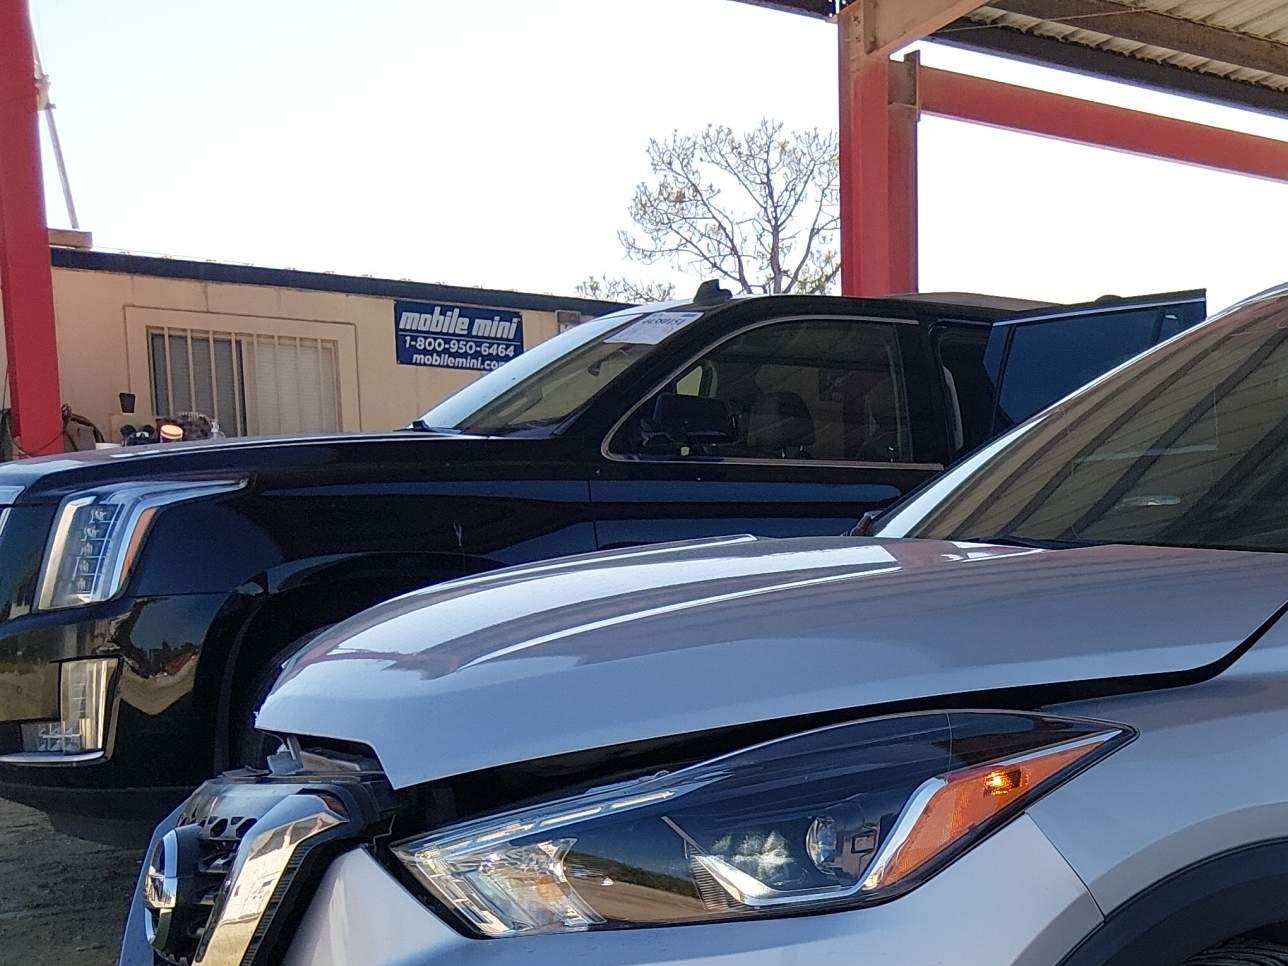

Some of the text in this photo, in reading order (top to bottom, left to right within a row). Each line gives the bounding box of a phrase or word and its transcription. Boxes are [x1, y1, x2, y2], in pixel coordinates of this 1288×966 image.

[399, 306, 519, 339] mobile mini
[405, 336, 515, 357] 1-800-950-6464
